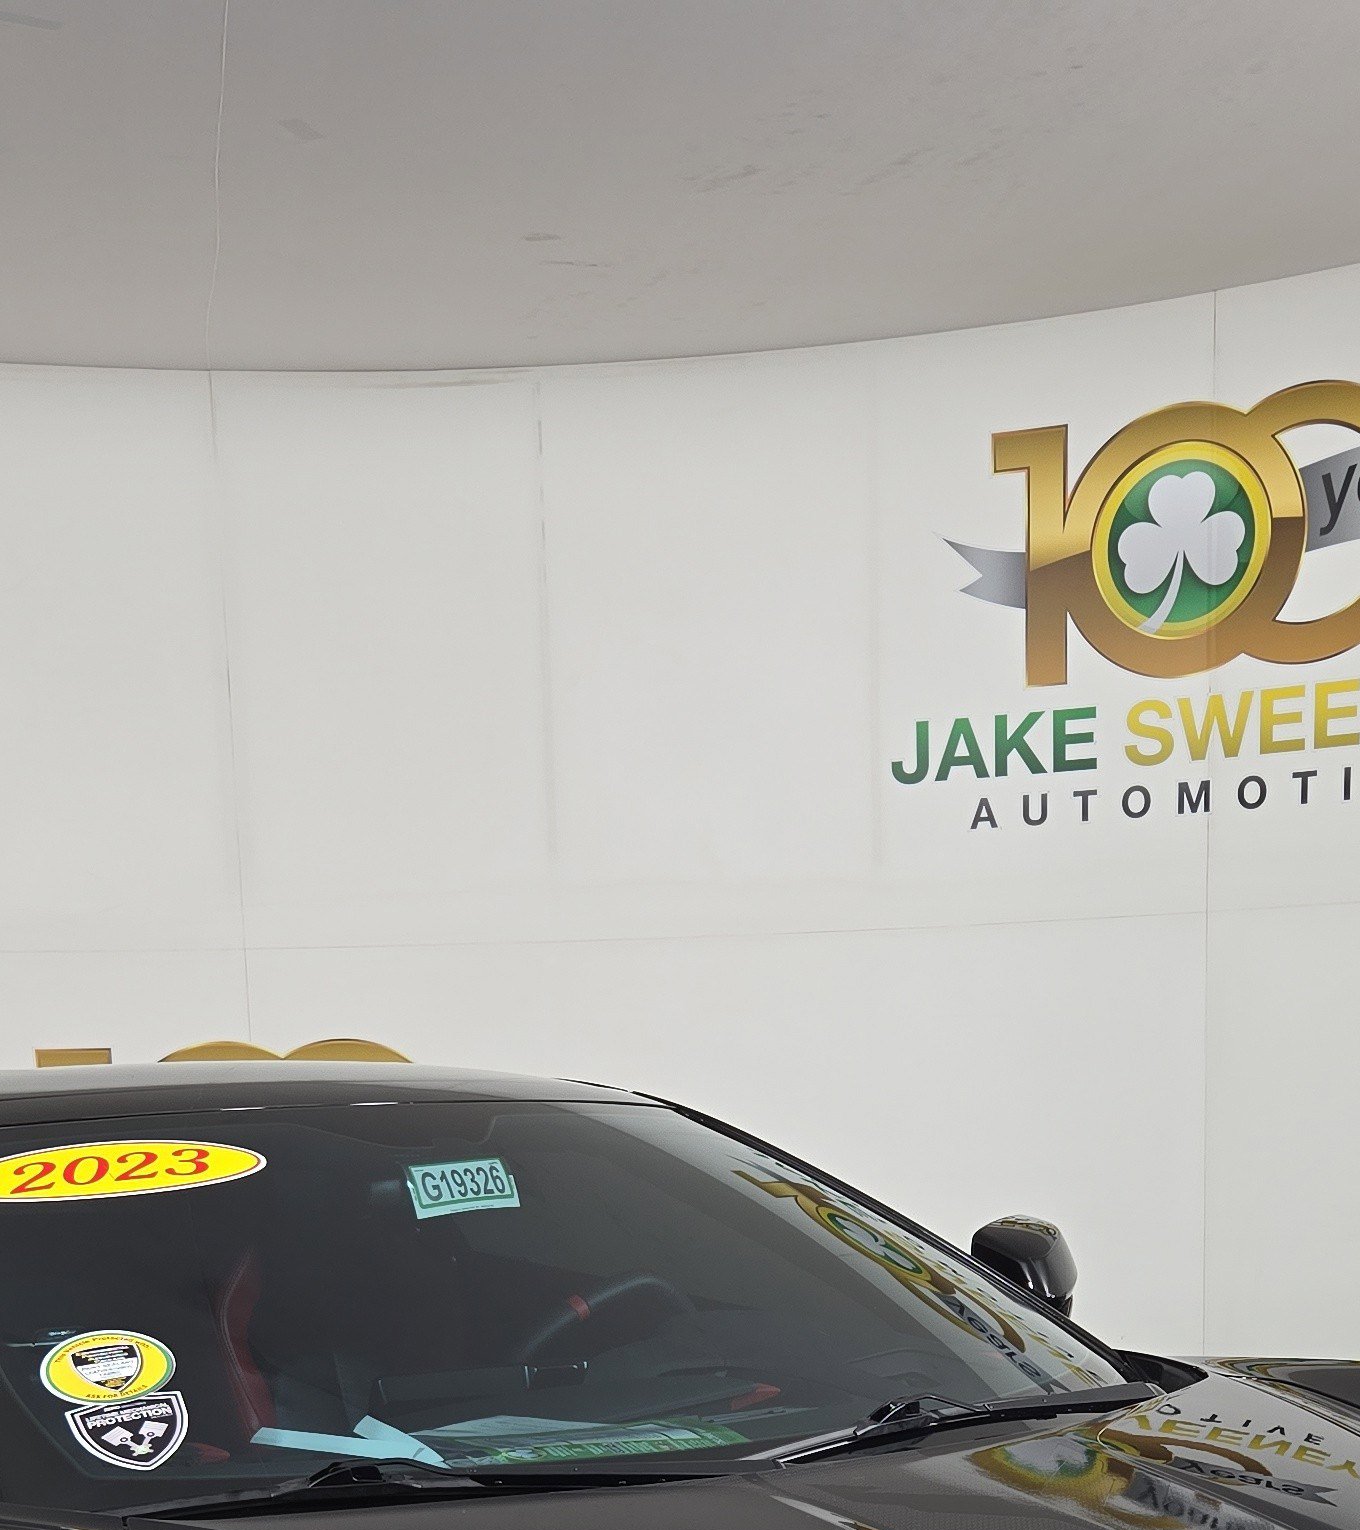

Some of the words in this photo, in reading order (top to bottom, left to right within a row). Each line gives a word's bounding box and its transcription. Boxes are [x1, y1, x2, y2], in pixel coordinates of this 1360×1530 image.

[891, 707, 1097, 785] JAKE
[10, 1147, 210, 1195] 2023
[421, 1165, 506, 1201] G19326
[86, 1405, 173, 1430] PROTECTION
